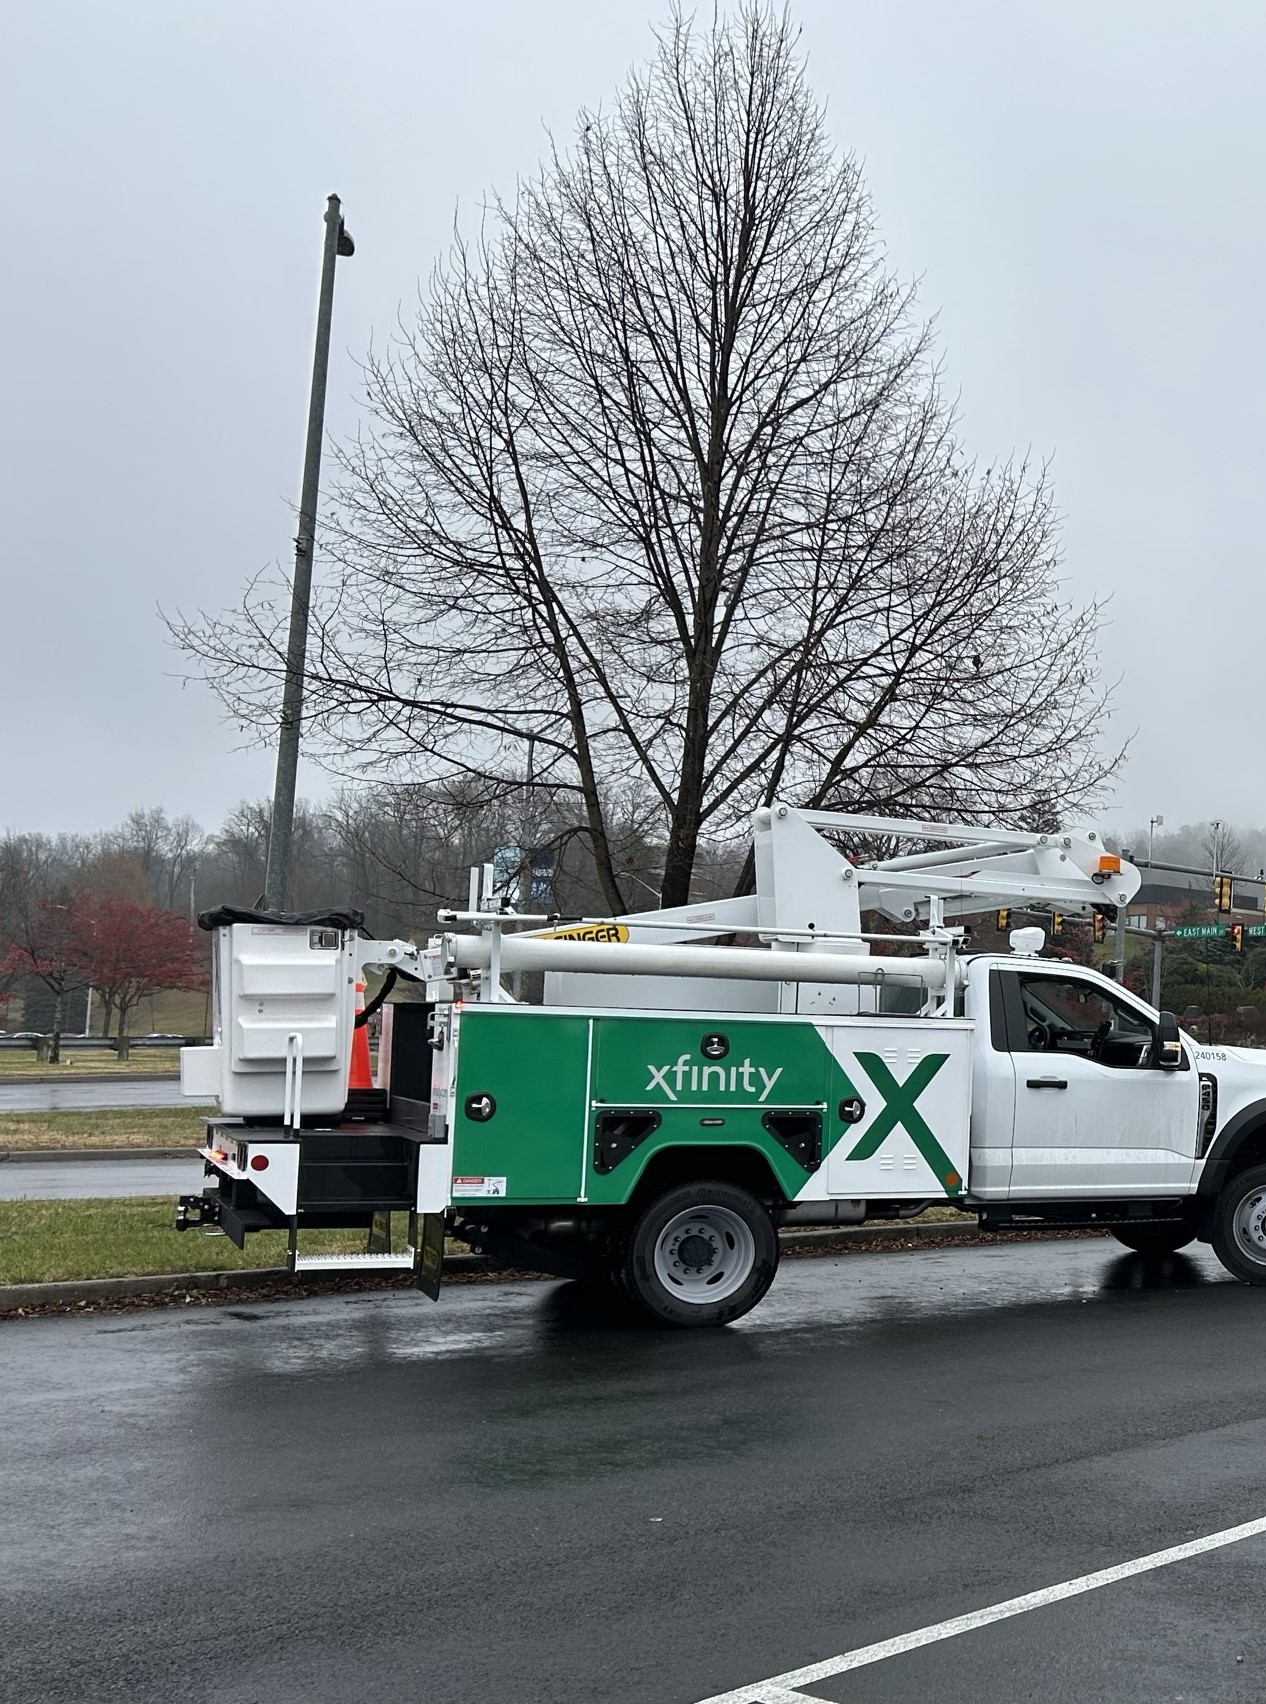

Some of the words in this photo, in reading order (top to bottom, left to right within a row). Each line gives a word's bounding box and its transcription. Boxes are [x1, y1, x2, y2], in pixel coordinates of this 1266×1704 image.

[1183, 928, 1199, 939] EAST
[1202, 926, 1218, 938] MAIN
[1248, 926, 1265, 936] WEST
[1195, 1051, 1227, 1061] 240158
[644, 1053, 784, 1102] xfinity
